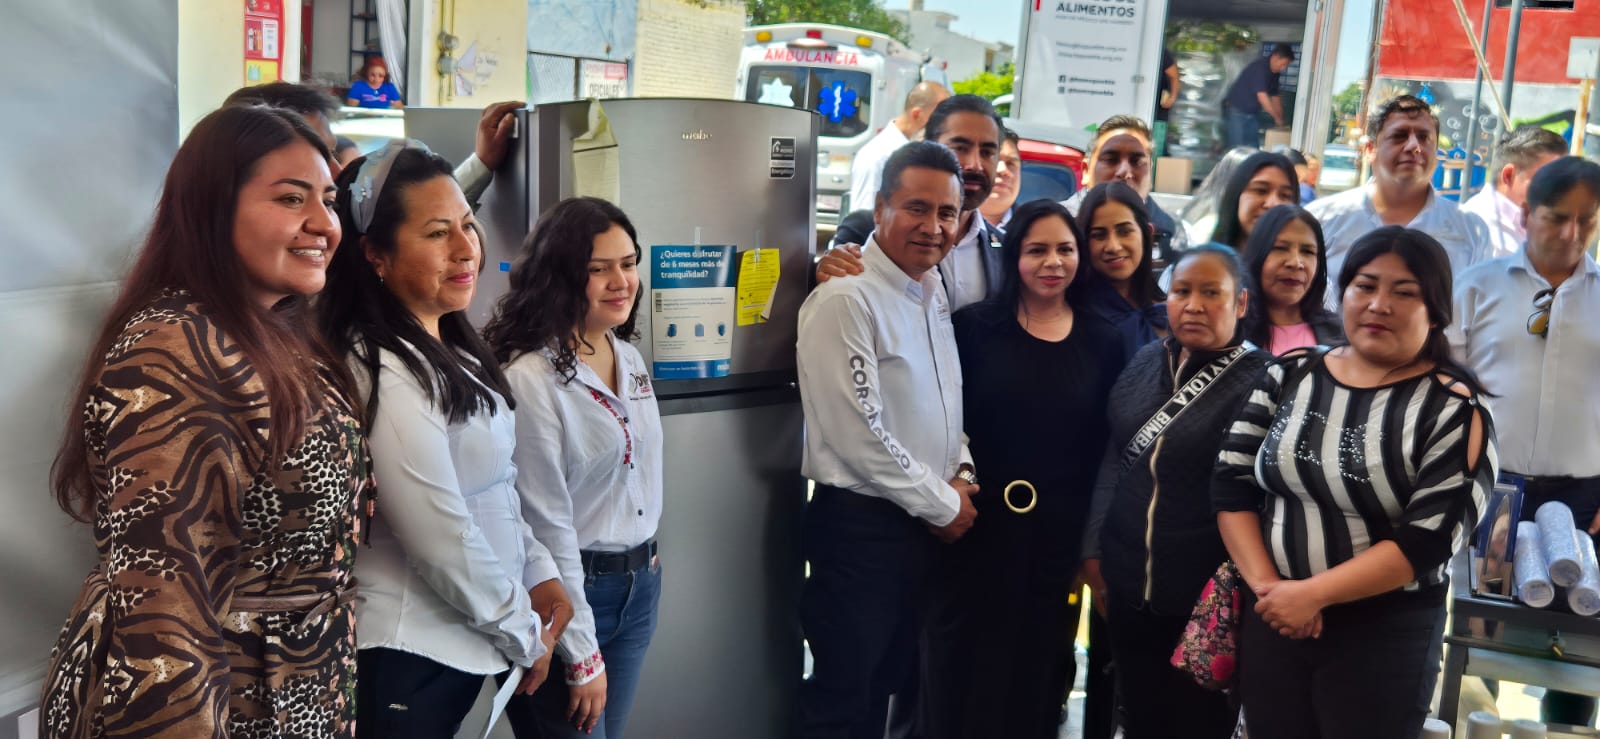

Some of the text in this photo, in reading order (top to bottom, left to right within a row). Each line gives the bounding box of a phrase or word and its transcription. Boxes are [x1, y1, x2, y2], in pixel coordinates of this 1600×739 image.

[1056, 3, 1135, 18] ALIMENTOS
[764, 48, 859, 65] AMBULANCIA
[660, 250, 722, 259] ¿Quieres dsfrutar
[701, 260, 715, 268] más
[660, 270, 709, 279] tranquilidad?
